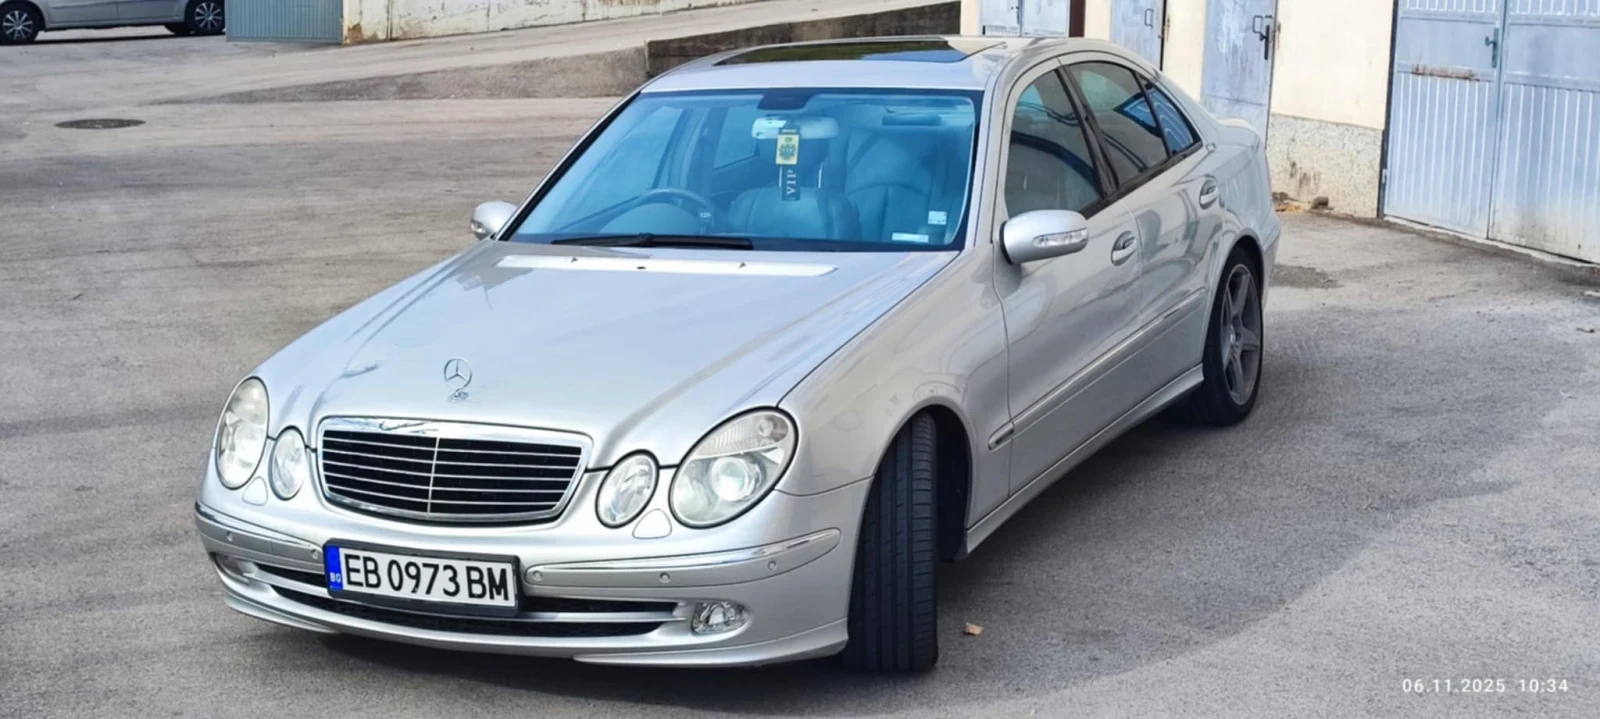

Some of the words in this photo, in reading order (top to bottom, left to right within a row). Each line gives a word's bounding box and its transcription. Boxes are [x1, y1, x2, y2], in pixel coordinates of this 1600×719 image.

[786, 169, 797, 195] VIP
[329, 572, 342, 583] BG
[344, 553, 381, 589] EB
[387, 559, 460, 597] 0973
[465, 566, 510, 601] BM
